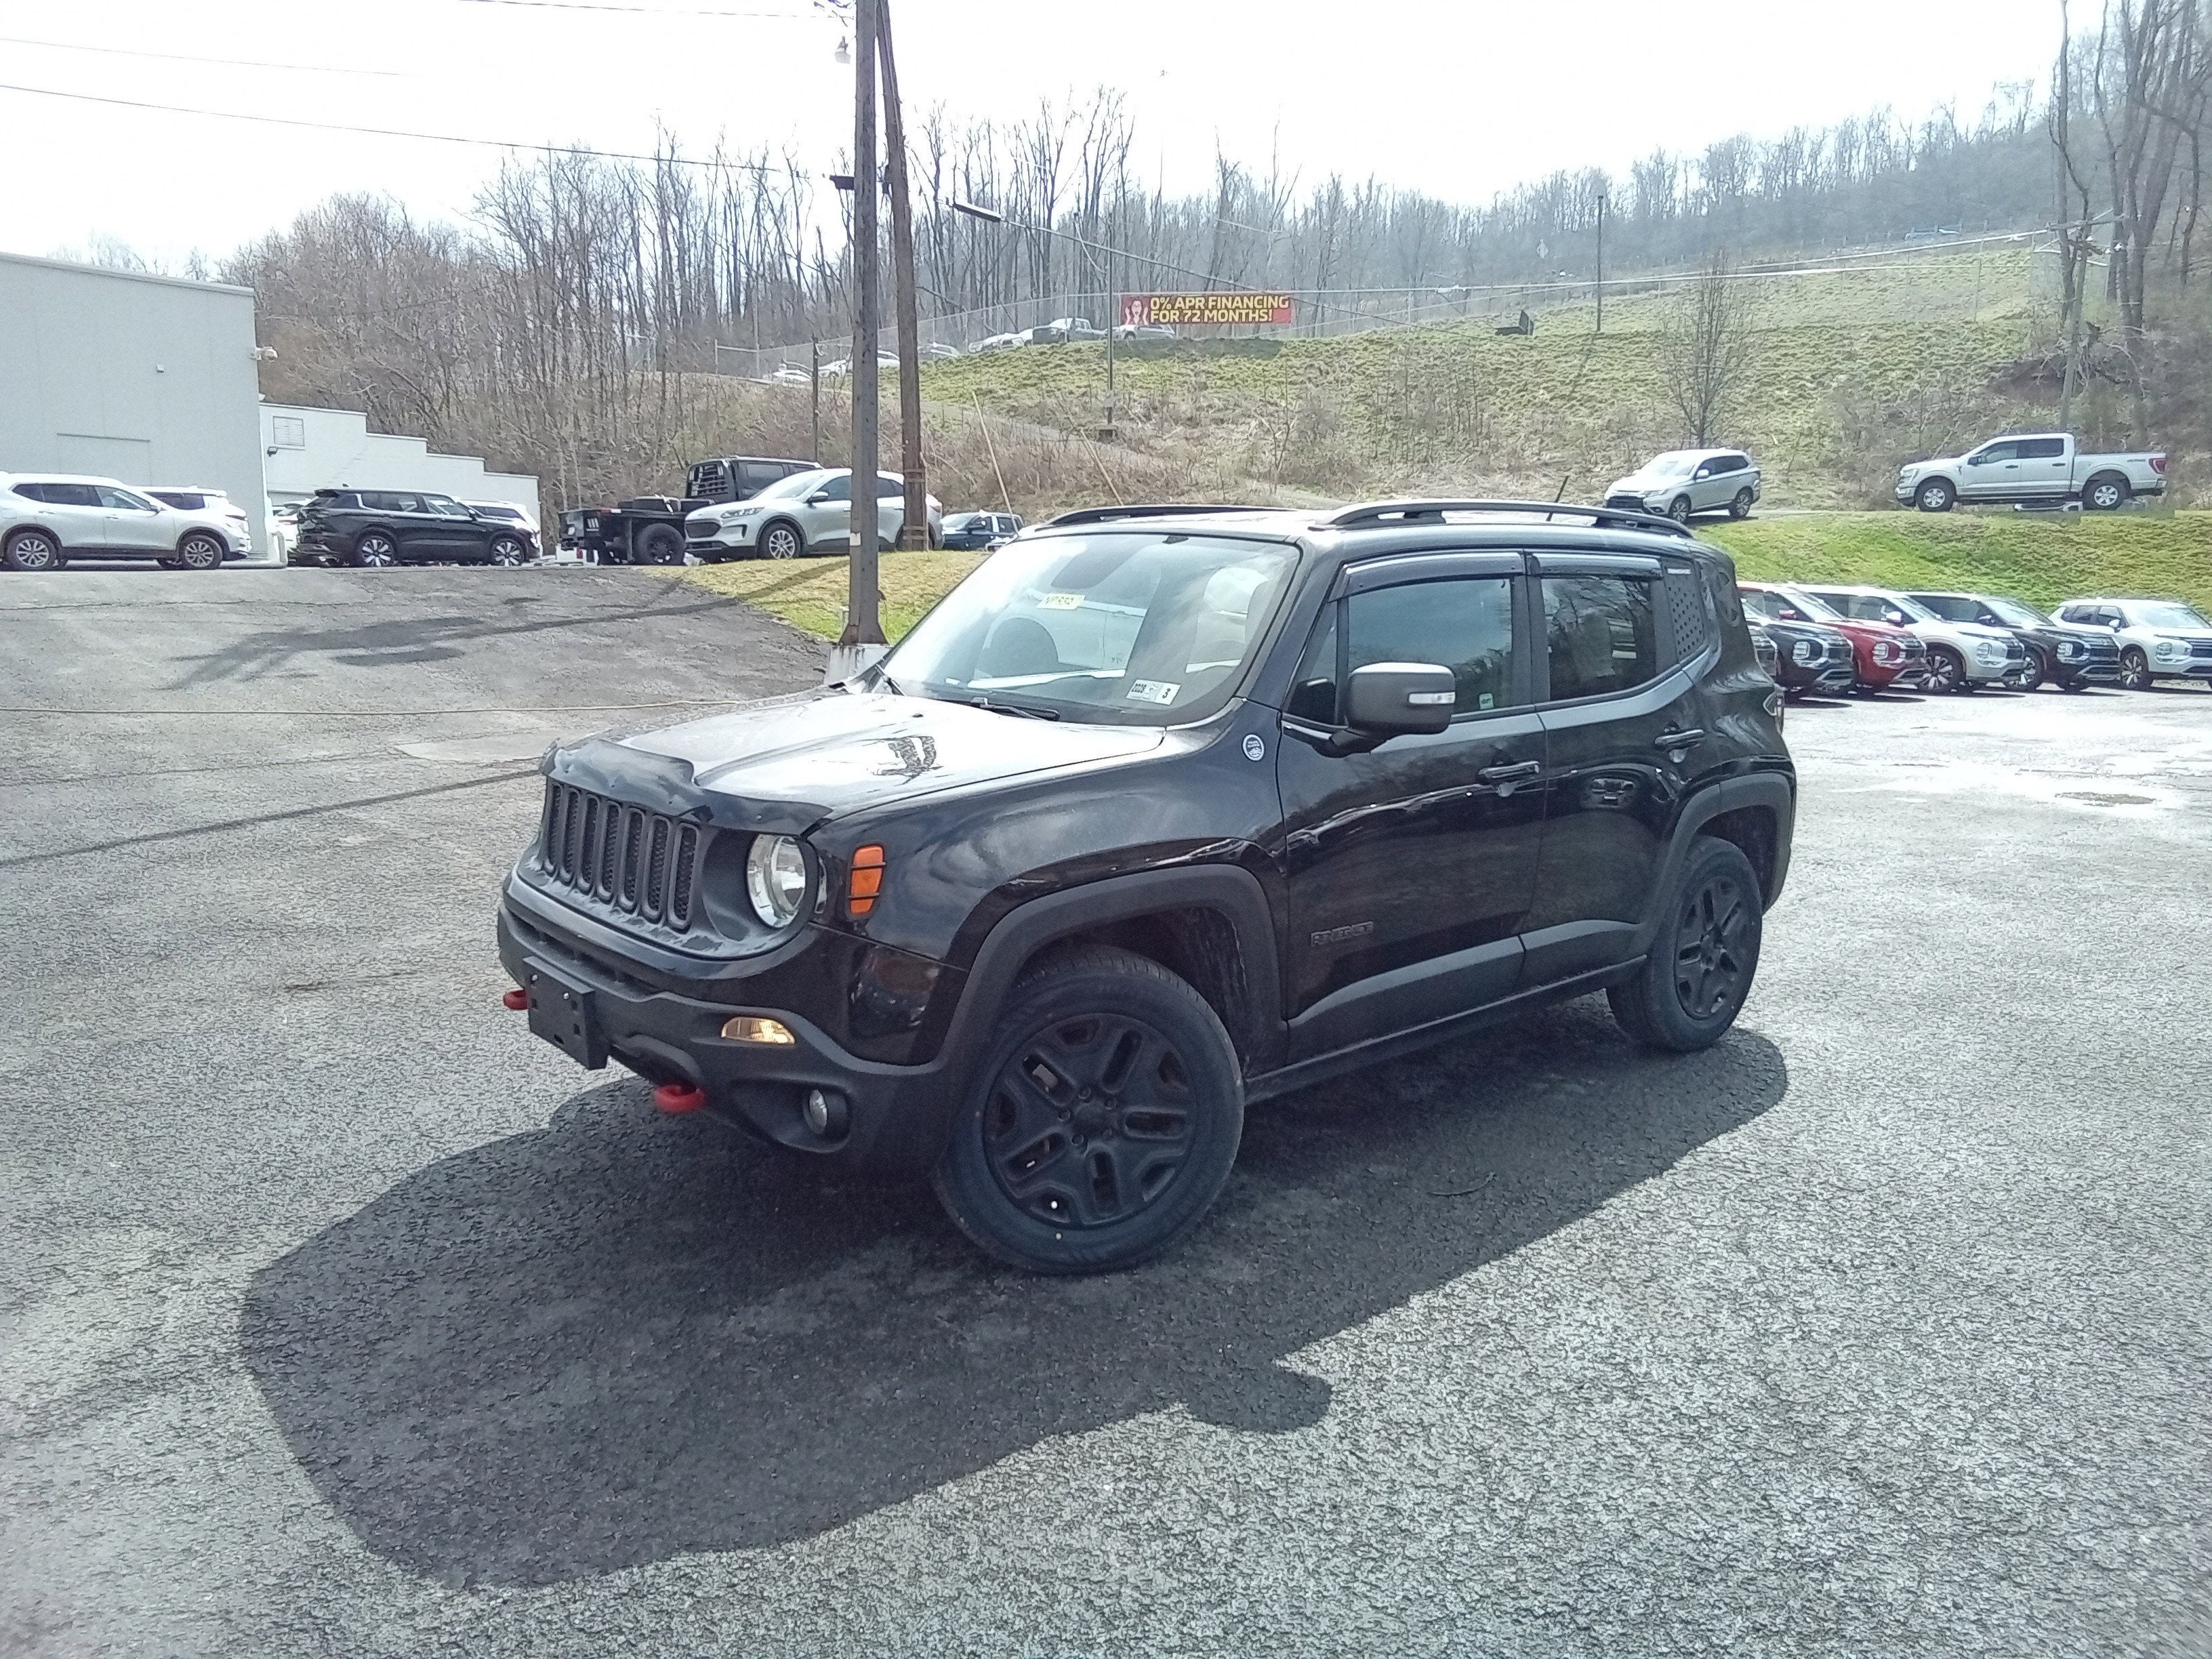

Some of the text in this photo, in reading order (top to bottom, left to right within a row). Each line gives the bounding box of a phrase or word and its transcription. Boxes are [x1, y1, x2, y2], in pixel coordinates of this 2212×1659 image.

[1150, 295, 1290, 310] 0% APR FINANCING
[1150, 308, 1273, 323] FOR 72 MONTHS!
